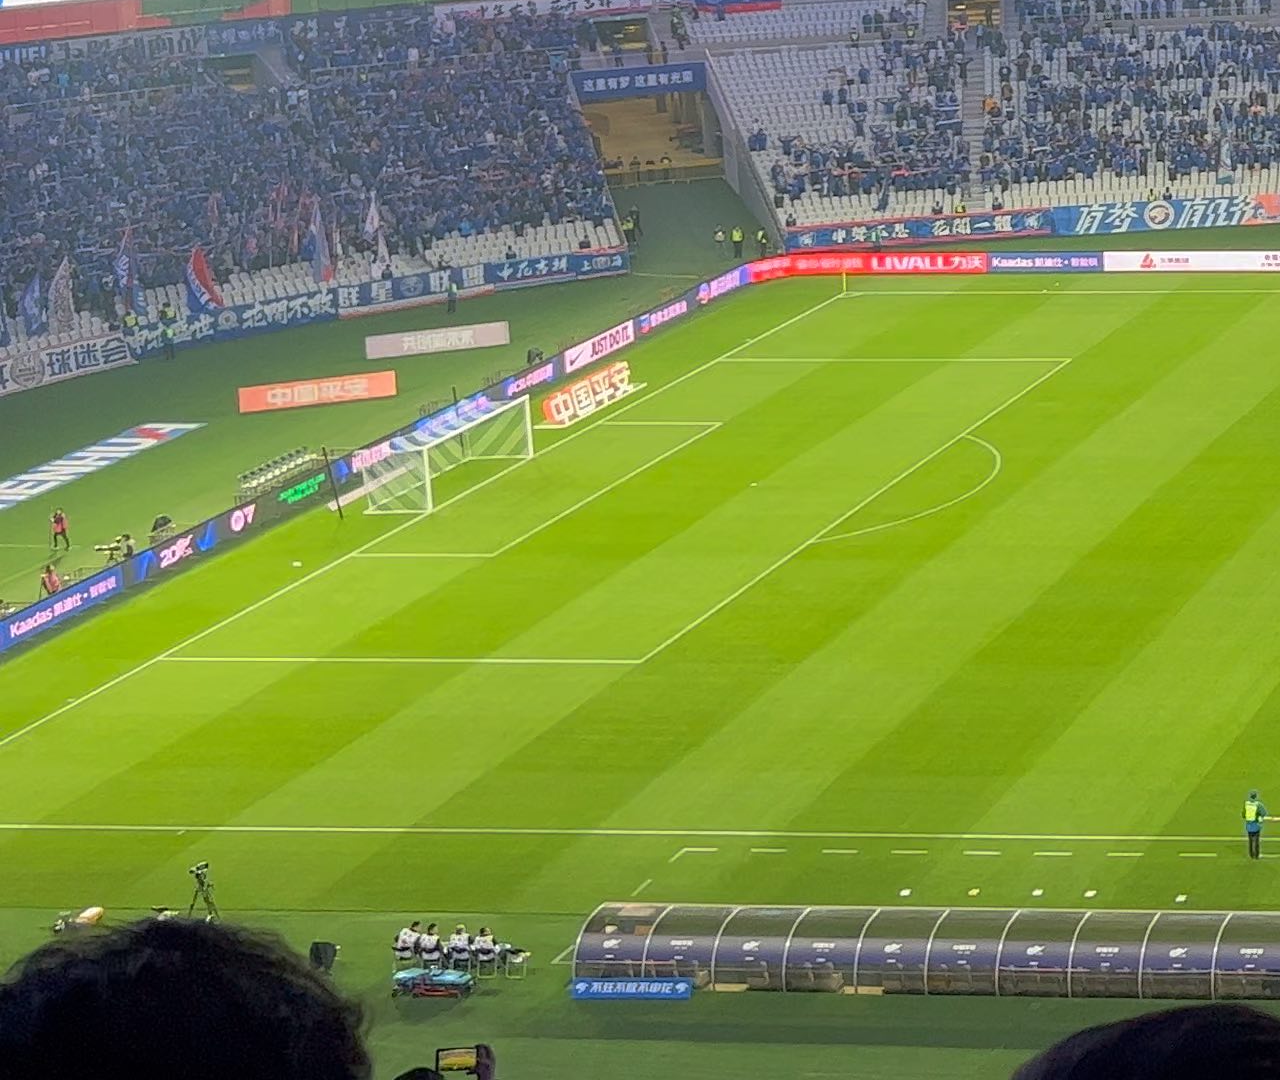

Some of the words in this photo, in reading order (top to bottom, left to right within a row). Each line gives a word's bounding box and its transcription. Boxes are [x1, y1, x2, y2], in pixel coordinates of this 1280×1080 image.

[991, 256, 1034, 268] Kaadas
[45, 337, 129, 377] 球迷会
[590, 338, 608, 359] JUST
[266, 378, 369, 406] 中国平安
[551, 361, 633, 424] 中国平安
[9, 606, 53, 638] Kaadas
